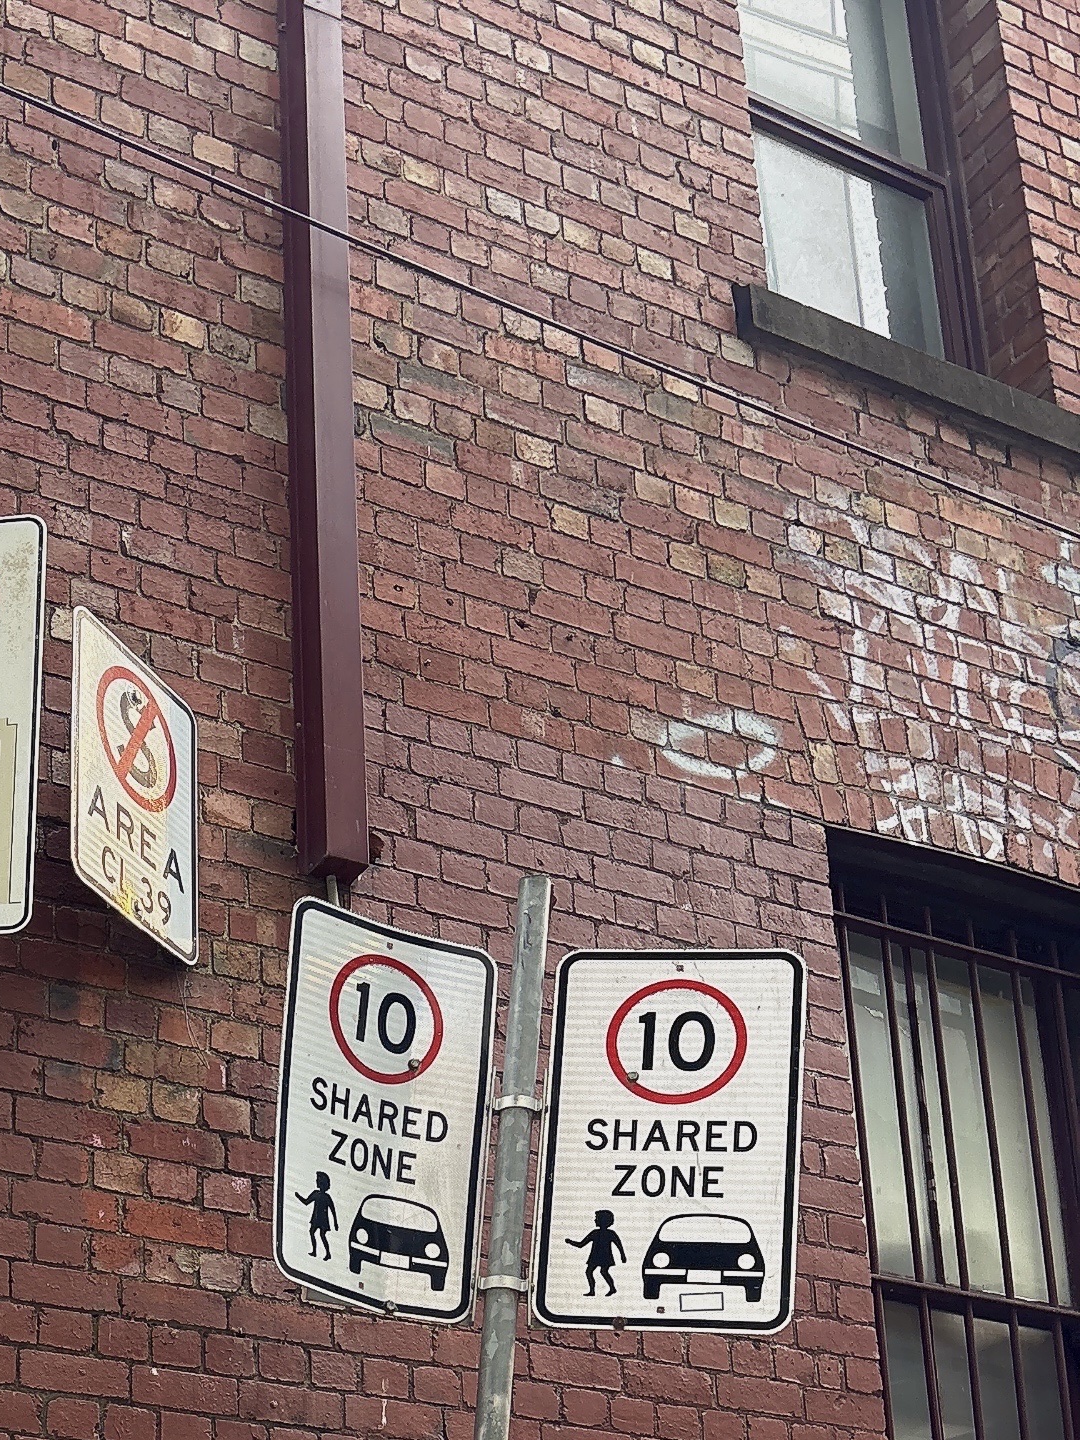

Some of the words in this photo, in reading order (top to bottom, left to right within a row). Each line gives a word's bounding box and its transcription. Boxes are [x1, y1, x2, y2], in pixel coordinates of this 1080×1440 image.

[88, 785, 184, 894] AREA
[355, 981, 417, 1054] 10
[638, 1010, 716, 1072] 10
[310, 1076, 448, 1142] SHARED
[585, 1118, 758, 1152] SHARED
[328, 1129, 417, 1185] ZONE
[611, 1164, 725, 1198] ZONE
